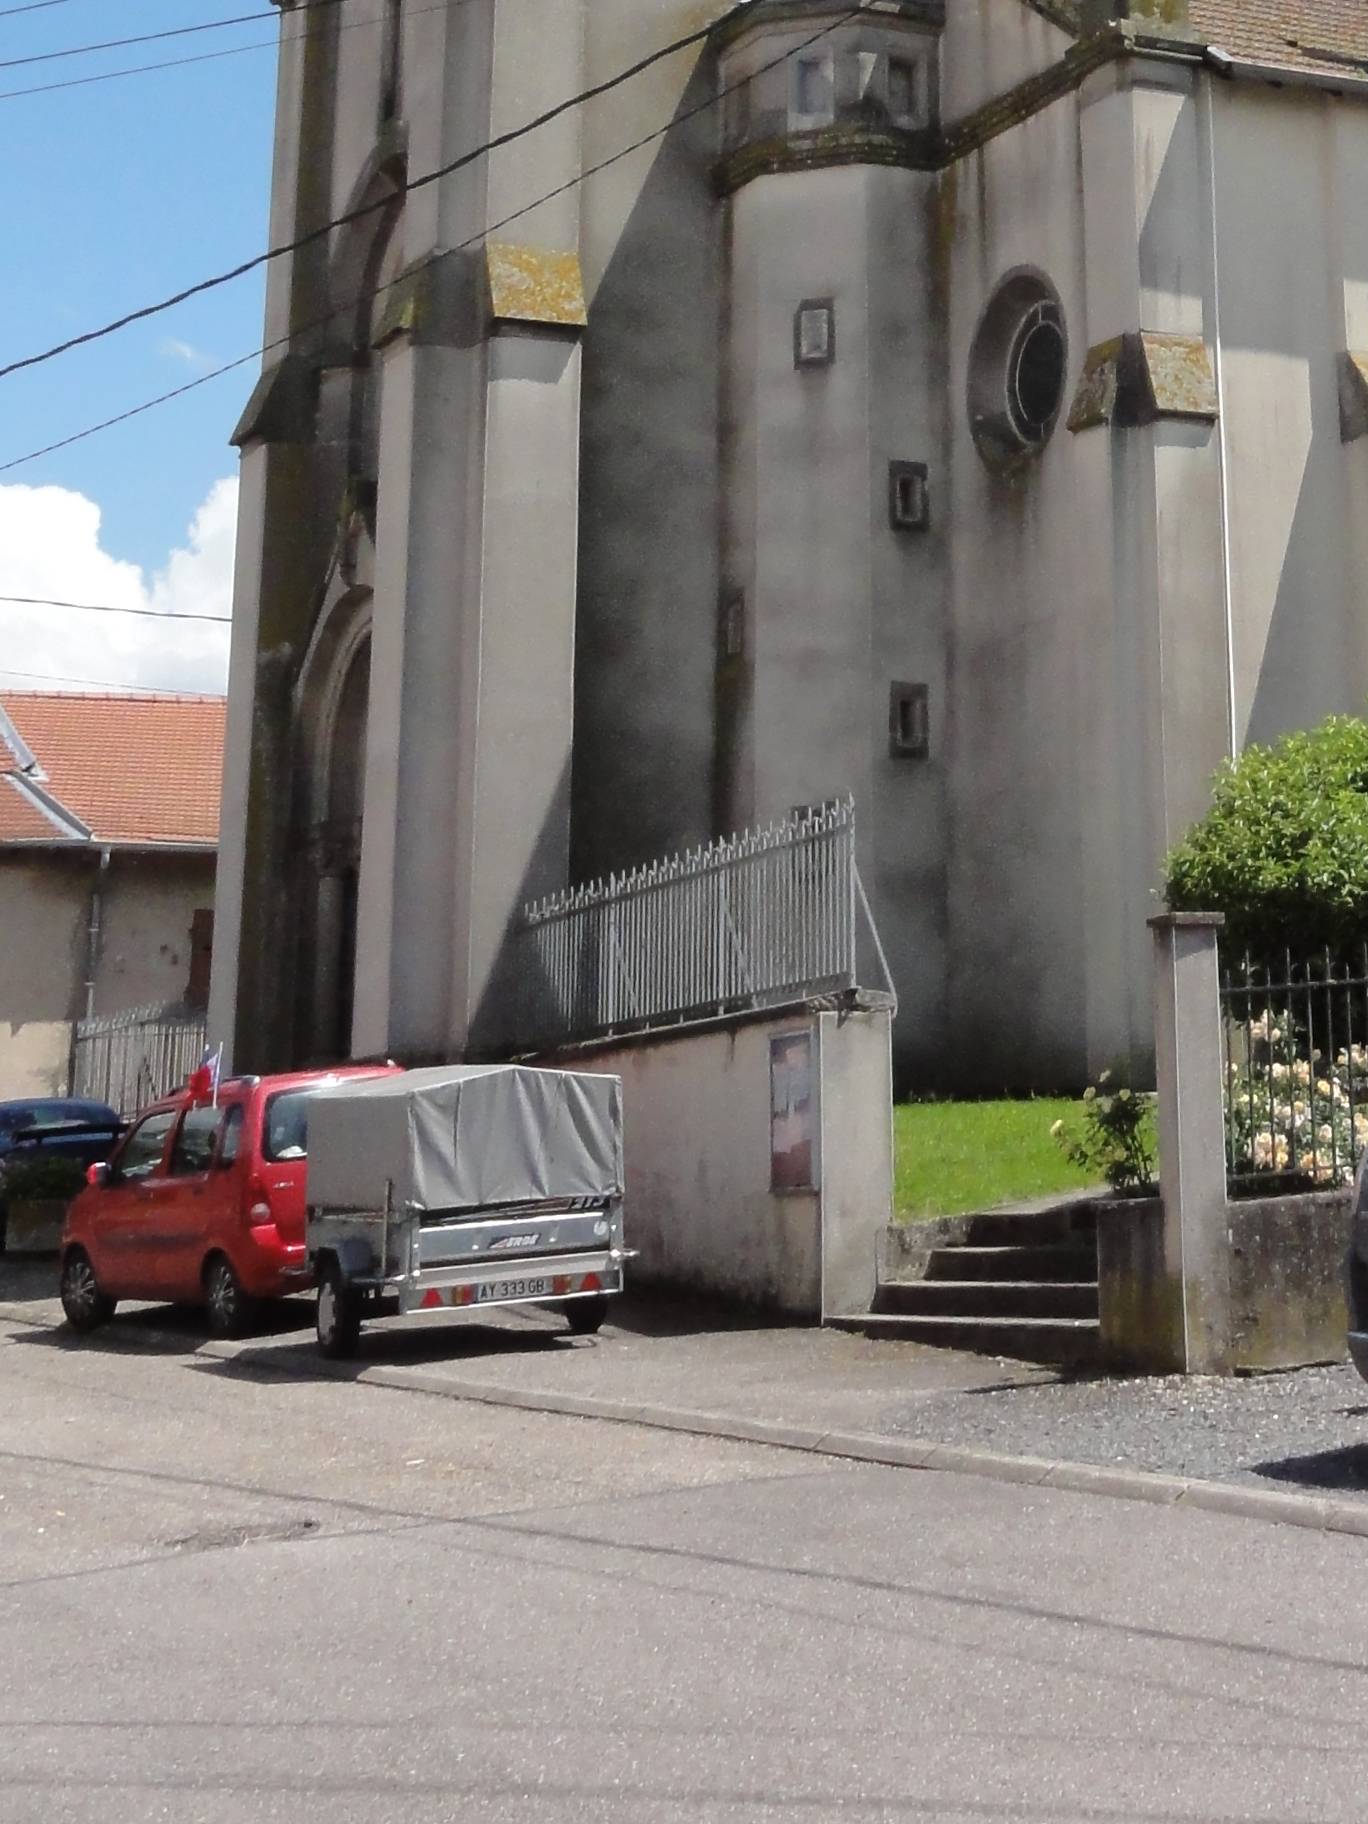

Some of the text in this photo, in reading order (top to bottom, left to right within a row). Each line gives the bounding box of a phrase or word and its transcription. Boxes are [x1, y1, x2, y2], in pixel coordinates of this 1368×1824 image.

[480, 1278, 545, 1299] AY 333 GB
